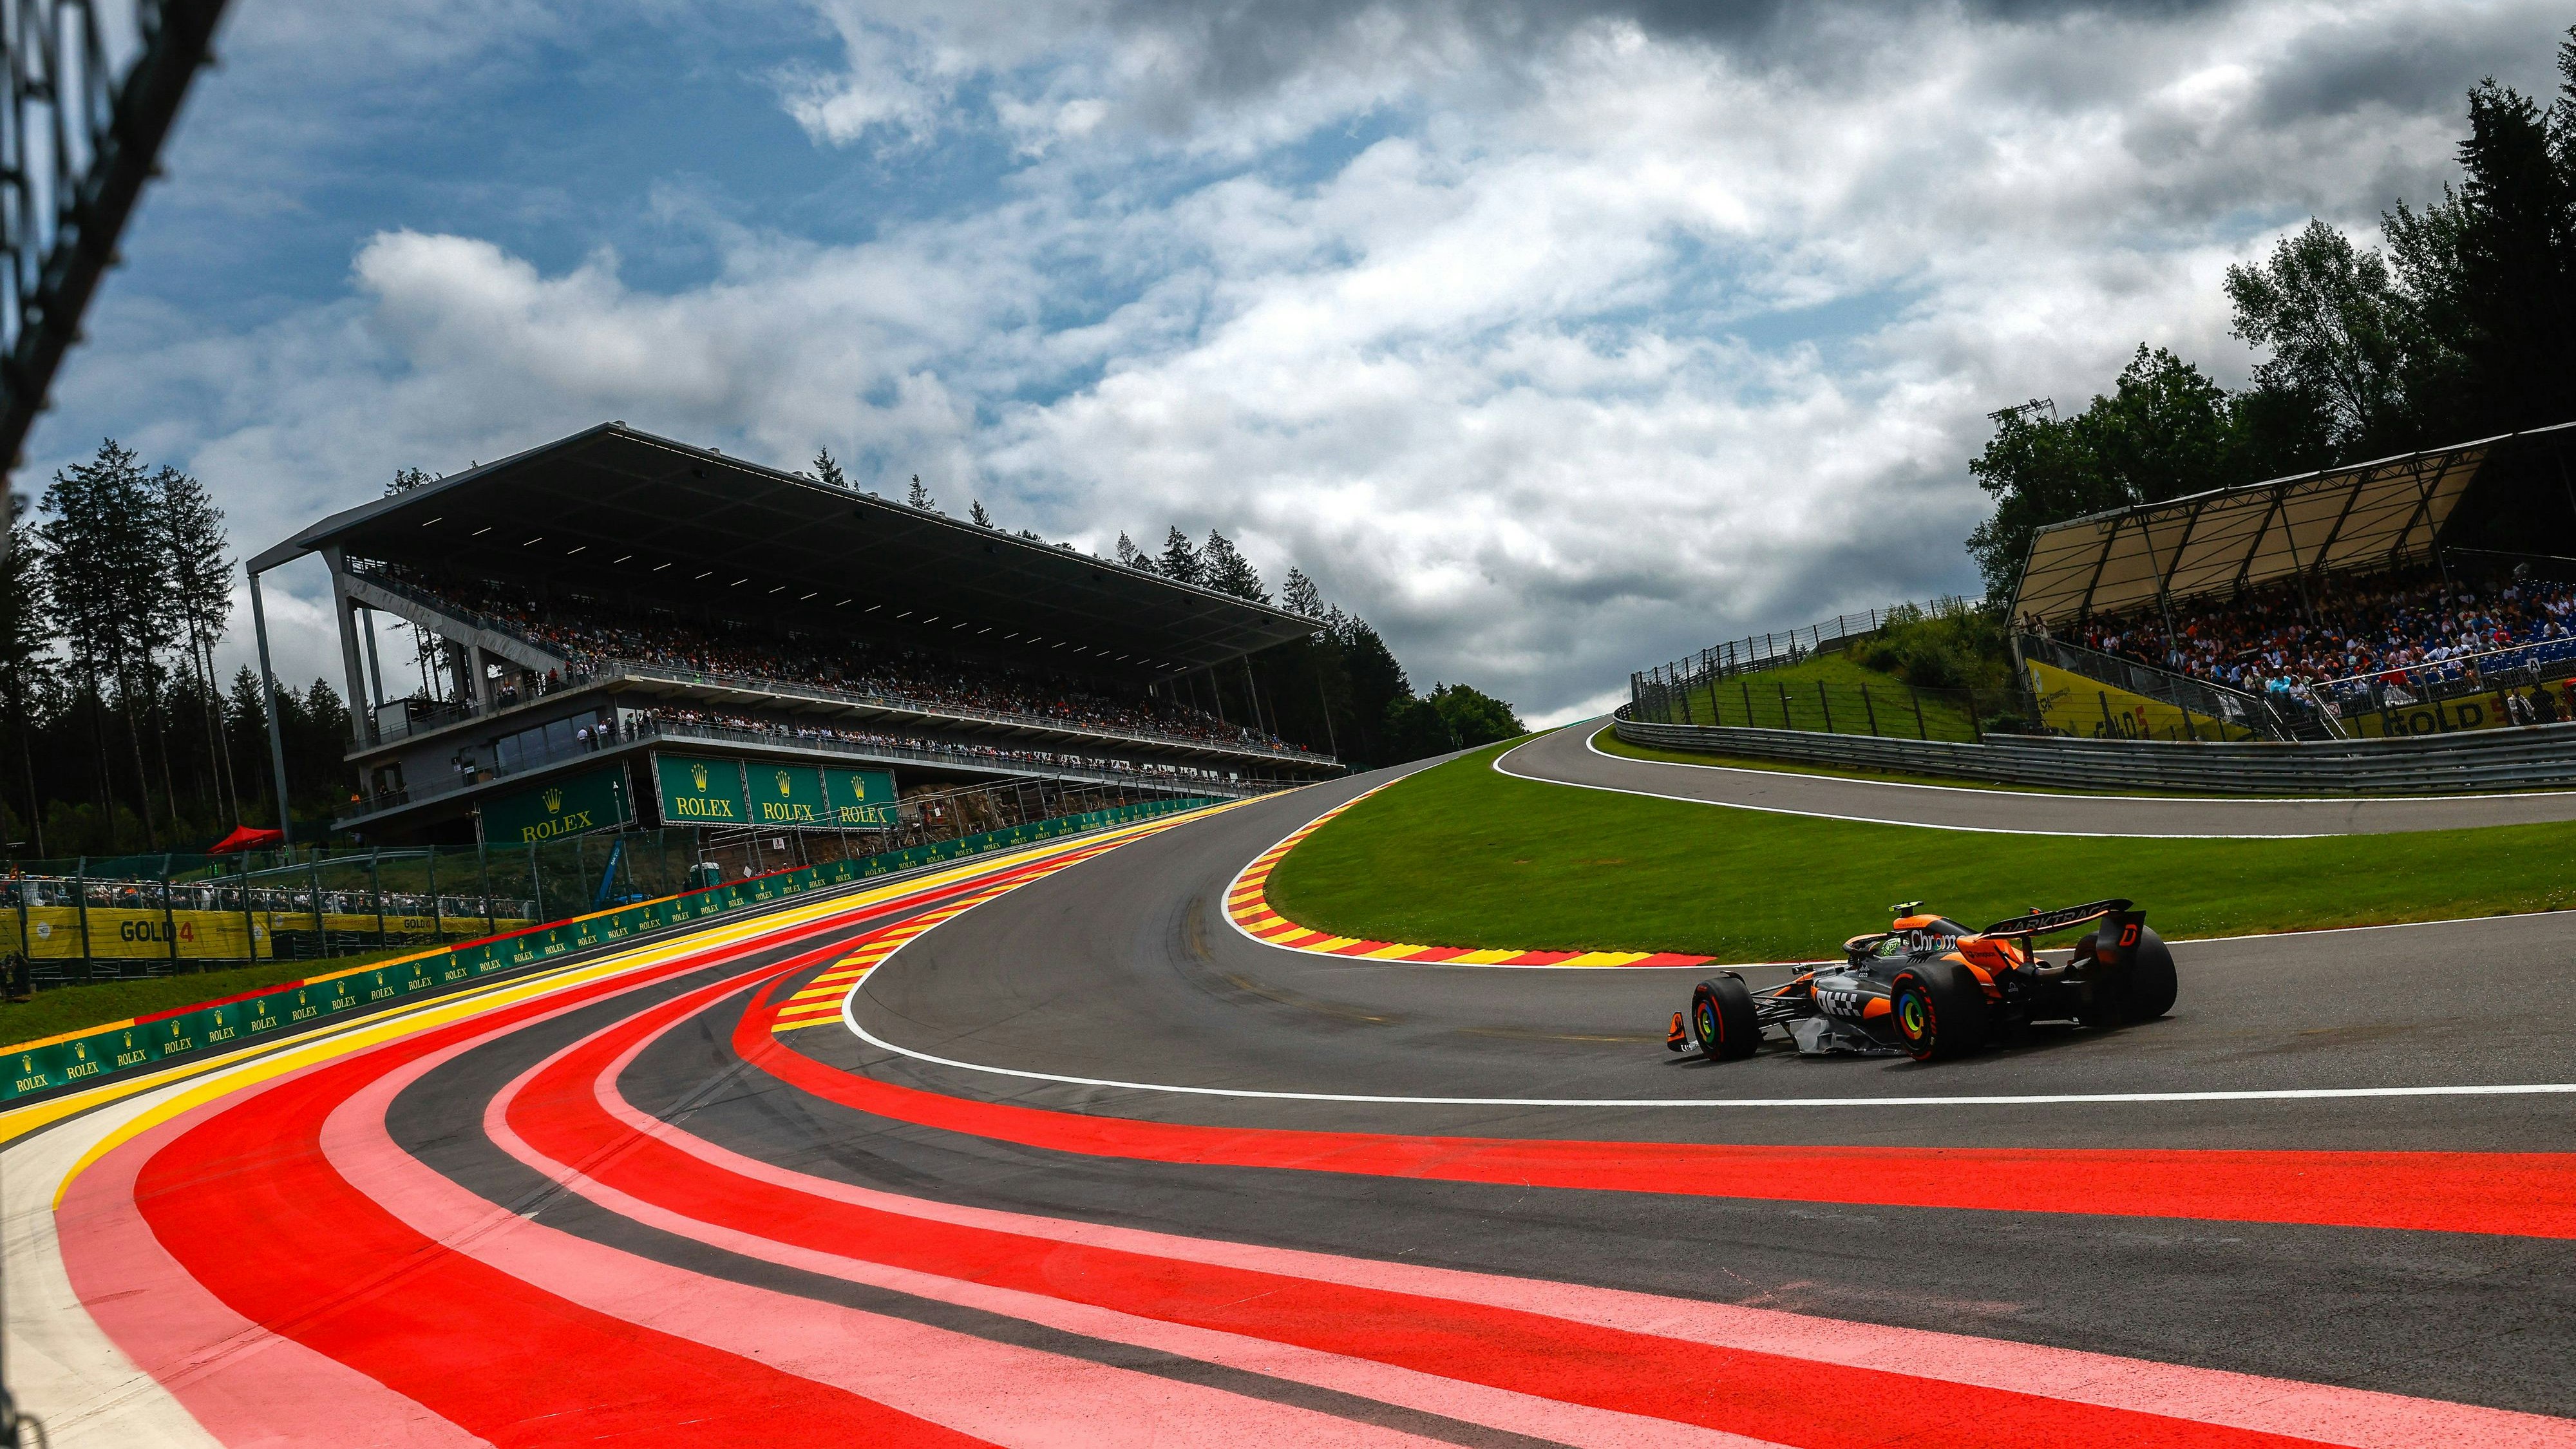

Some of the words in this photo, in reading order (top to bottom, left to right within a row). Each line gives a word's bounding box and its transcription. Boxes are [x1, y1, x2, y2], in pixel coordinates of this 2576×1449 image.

[2530, 660, 2540, 671] A
[676, 797, 734, 817] ROLEX
[762, 802, 815, 821] ROLEX
[840, 806, 887, 823] ROLEX
[522, 810, 593, 843] ROLEX
[955, 848, 973, 857] ROLEX
[983, 842, 1000, 851] ROLEX
[898, 860, 916, 869] ROLEX
[927, 855, 945, 864] ROLEX
[835, 873, 851, 882] ROLEX
[865, 867, 886, 876] ROLEX
[783, 884, 800, 894] ROLEX
[809, 879, 825, 888] ROLEX
[755, 891, 773, 900] ROLEX
[728, 898, 744, 907] ROLEX
[701, 904, 719, 914] ROLEX
[672, 911, 689, 922] ROLEX
[404, 919, 424, 929] GOLD
[639, 919, 661, 931] ROLEX
[180, 922, 194, 942] 4
[607, 927, 629, 938] ROLEX
[2119, 923, 2137, 947] D
[577, 935, 597, 947] ROLEX
[1911, 929, 1965, 952] Chrom
[545, 943, 565, 954] ROLEX
[513, 951, 533, 963] ROLEX
[480, 960, 501, 972] ROLEX
[445, 968, 467, 980] ROLEX
[408, 978, 432, 990] ROLEX
[371, 986, 394, 999] ROLEX
[332, 996, 355, 1009] ROLEX
[1816, 990, 1861, 1017] OKX
[292, 1006, 317, 1020] ROLEX
[251, 1016, 277, 1030] ROLEX
[209, 1027, 234, 1042] ROLEX
[164, 1037, 192, 1054] ROLEX
[117, 1050, 146, 1066] ROLEX
[66, 1061, 99, 1079] ROLEX
[16, 1074, 48, 1092] ROLEX
